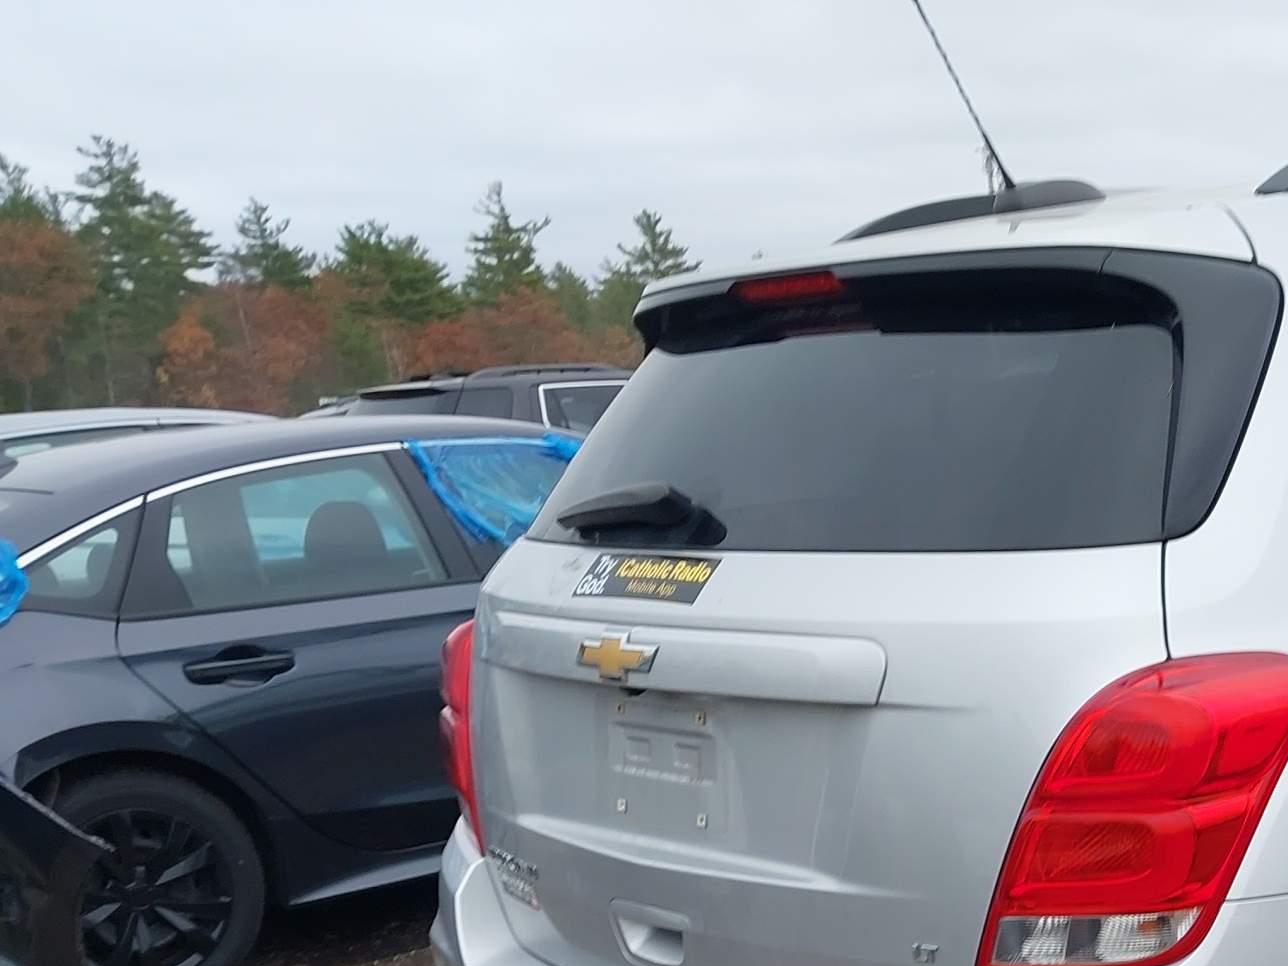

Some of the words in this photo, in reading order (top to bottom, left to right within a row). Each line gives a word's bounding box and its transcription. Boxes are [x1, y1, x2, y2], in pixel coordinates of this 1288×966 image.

[594, 555, 618, 577] Try
[668, 560, 712, 583] Radio
[625, 580, 656, 596] Mobile
[655, 582, 678, 598] App
